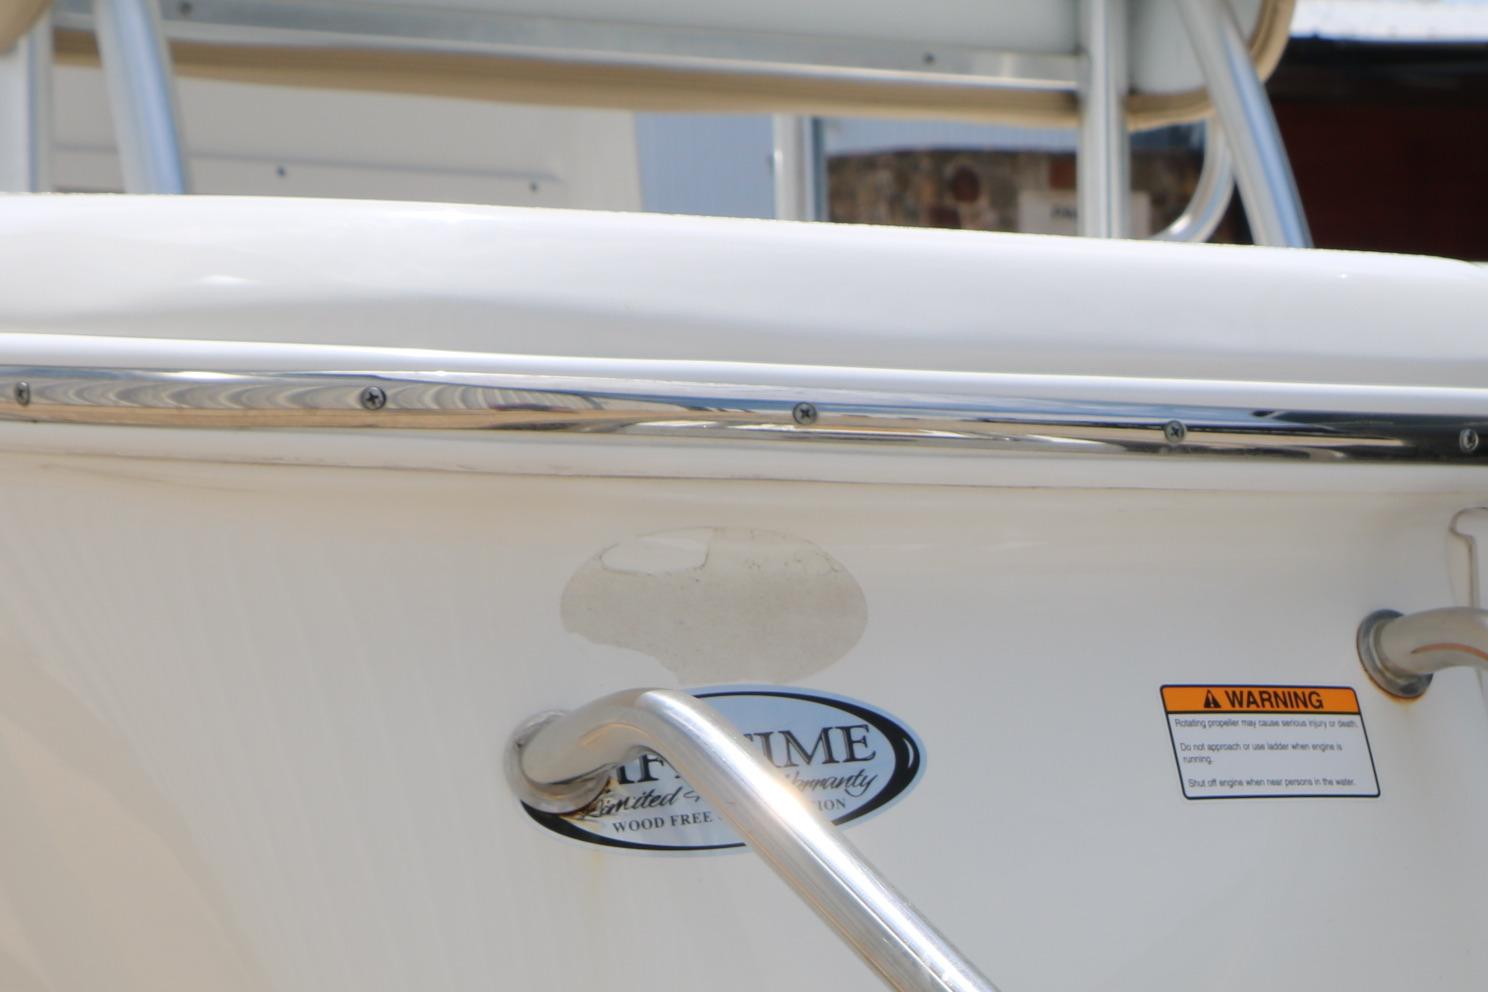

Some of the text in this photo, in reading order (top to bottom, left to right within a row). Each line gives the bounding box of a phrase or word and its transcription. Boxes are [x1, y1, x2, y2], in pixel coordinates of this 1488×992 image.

[1225, 690, 1324, 709] WARNING
[1175, 718, 1206, 728] Rotating
[1207, 718, 1239, 728] propeller
[1241, 720, 1256, 728] may
[1281, 719, 1307, 727] serious
[1309, 719, 1327, 728] injury
[1180, 743, 1191, 751] Do
[1193, 743, 1204, 751] not
[1207, 743, 1241, 752] approach
[1291, 742, 1310, 750] when
[1312, 743, 1335, 752] engine
[1188, 778, 1205, 787] Shut
[1207, 778, 1217, 786] off
[1219, 779, 1244, 788] engine
[1246, 778, 1265, 786] when
[1285, 779, 1313, 787] persons
[1315, 778, 1321, 786] in
[1322, 778, 1334, 786] the
[612, 811, 713, 833] WOOD FREE
